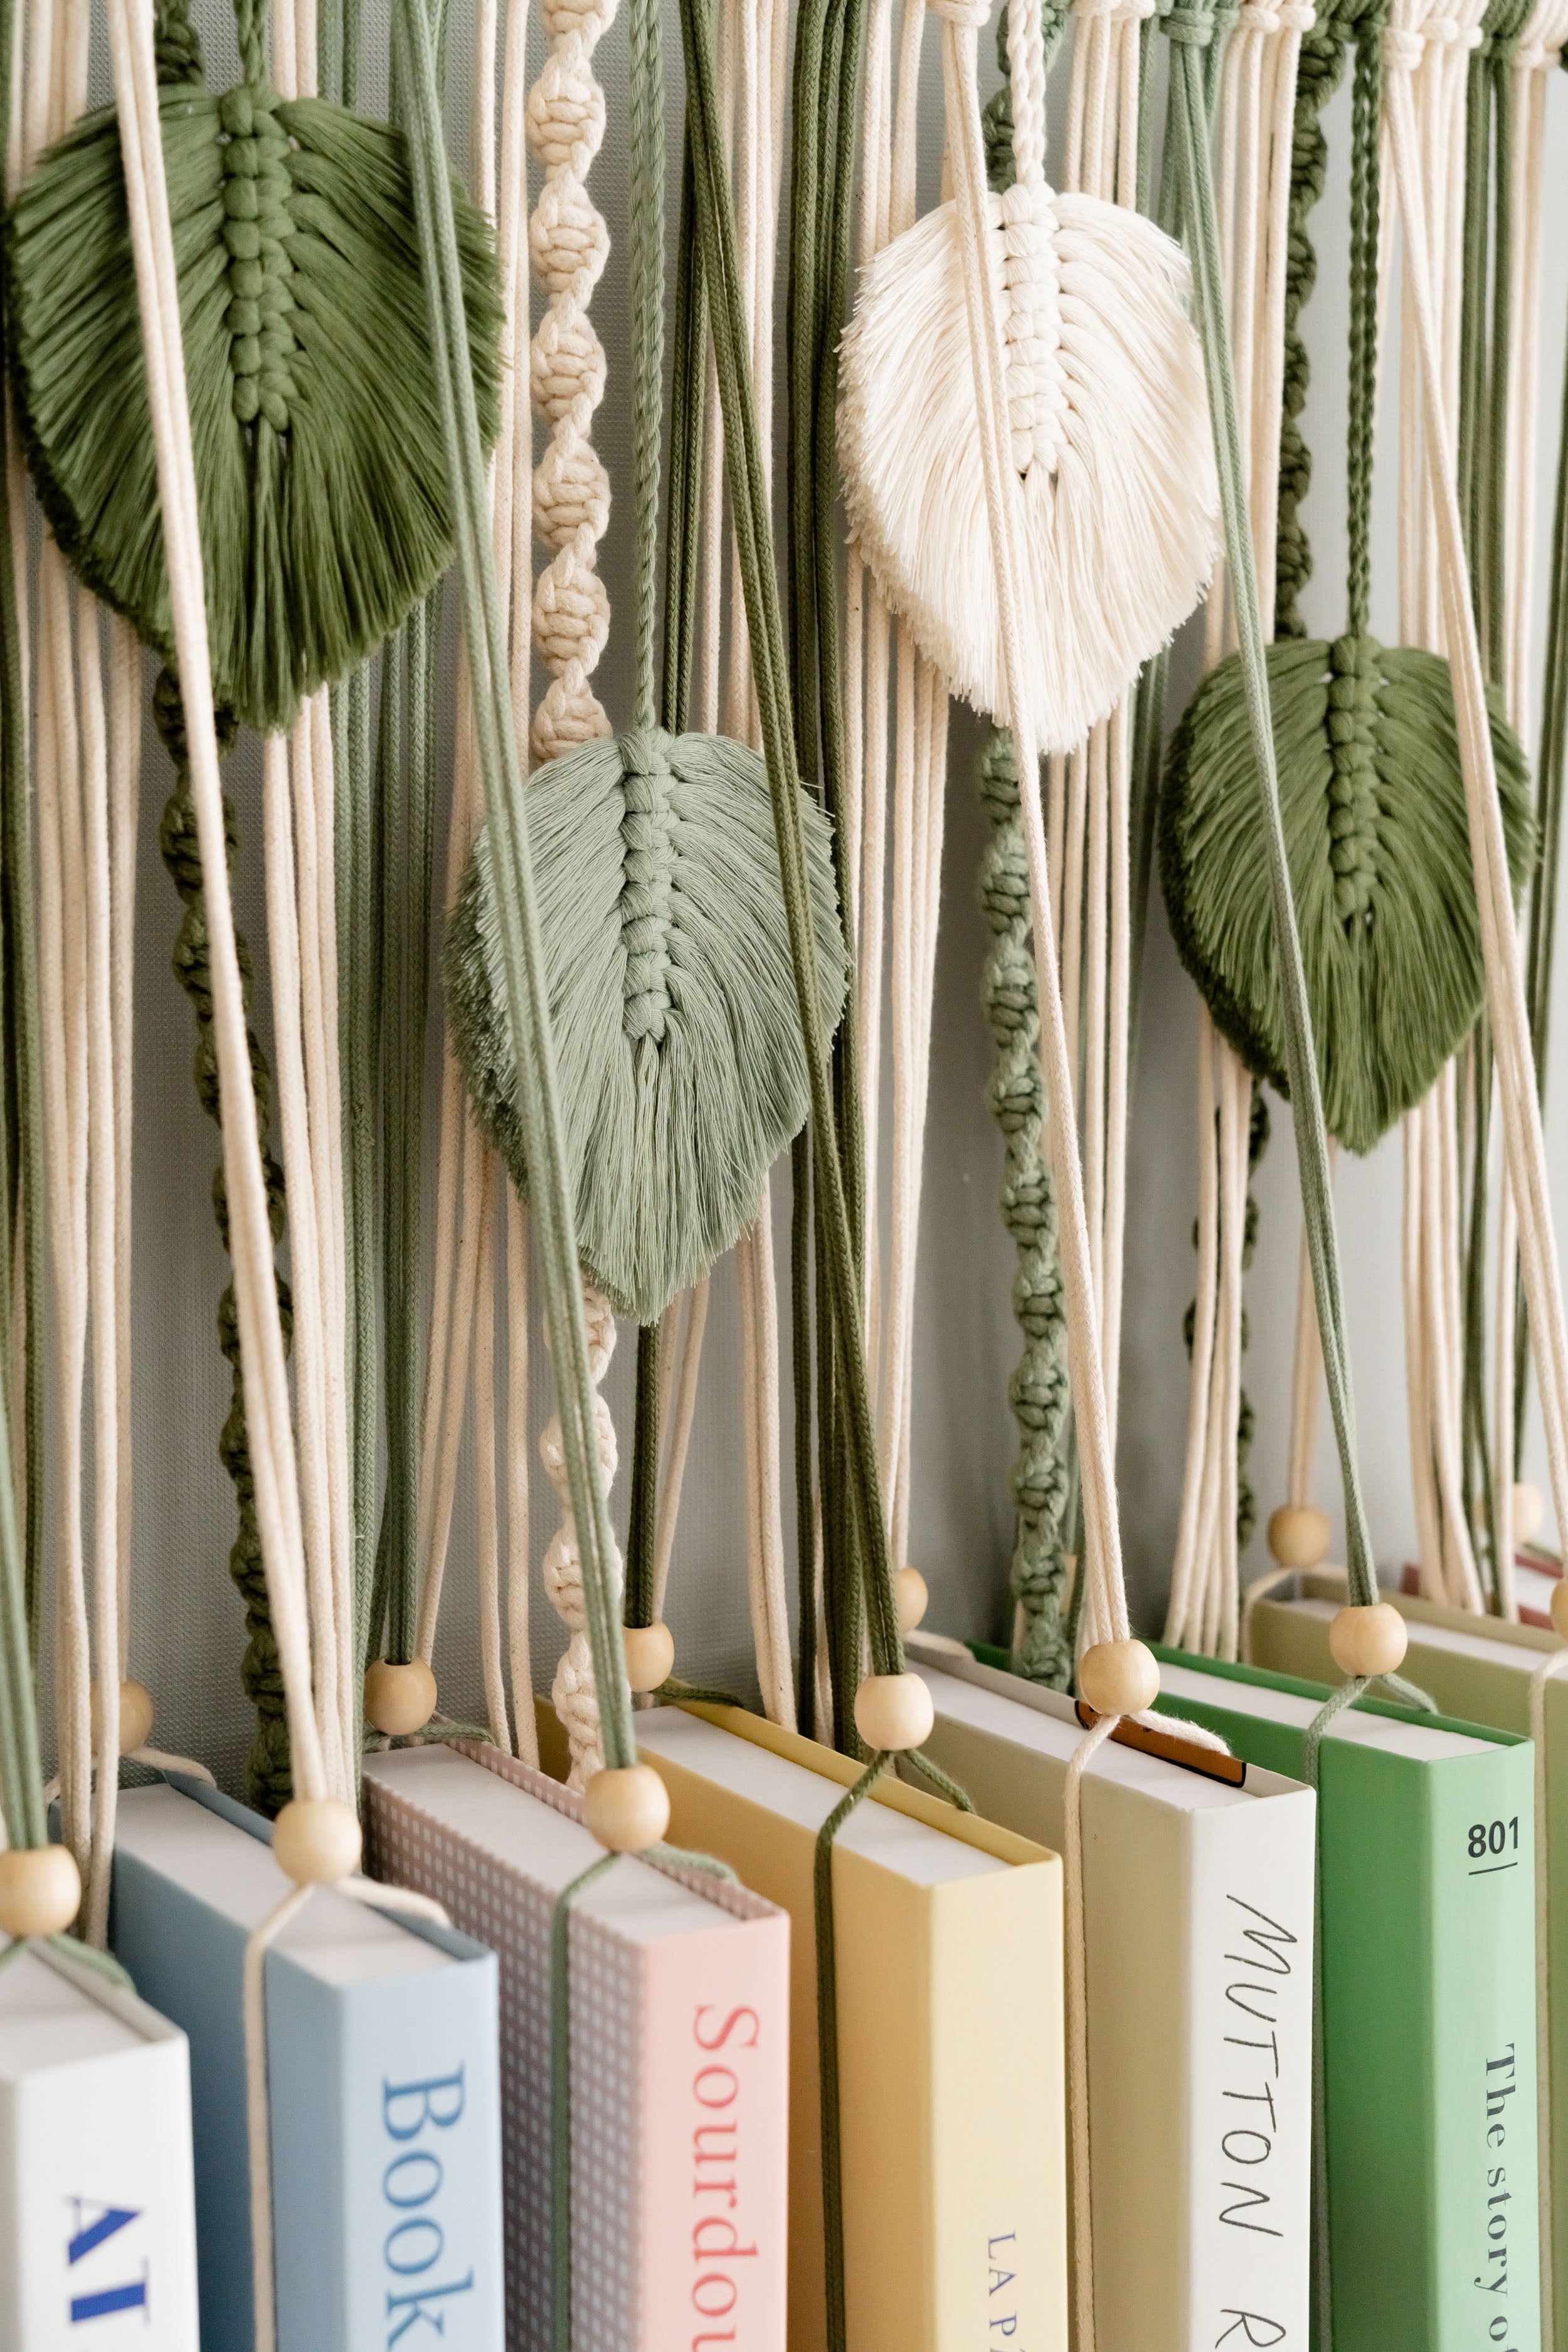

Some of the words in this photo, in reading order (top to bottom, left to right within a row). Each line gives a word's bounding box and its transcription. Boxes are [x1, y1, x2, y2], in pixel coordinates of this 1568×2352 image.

[1468, 1816, 1518, 1858] 801
[1218, 1894, 1298, 2238] MUTTON
[1486, 2042, 1516, 2149] The
[382, 2059, 475, 2352] Book
[1474, 2166, 1508, 2298] story
